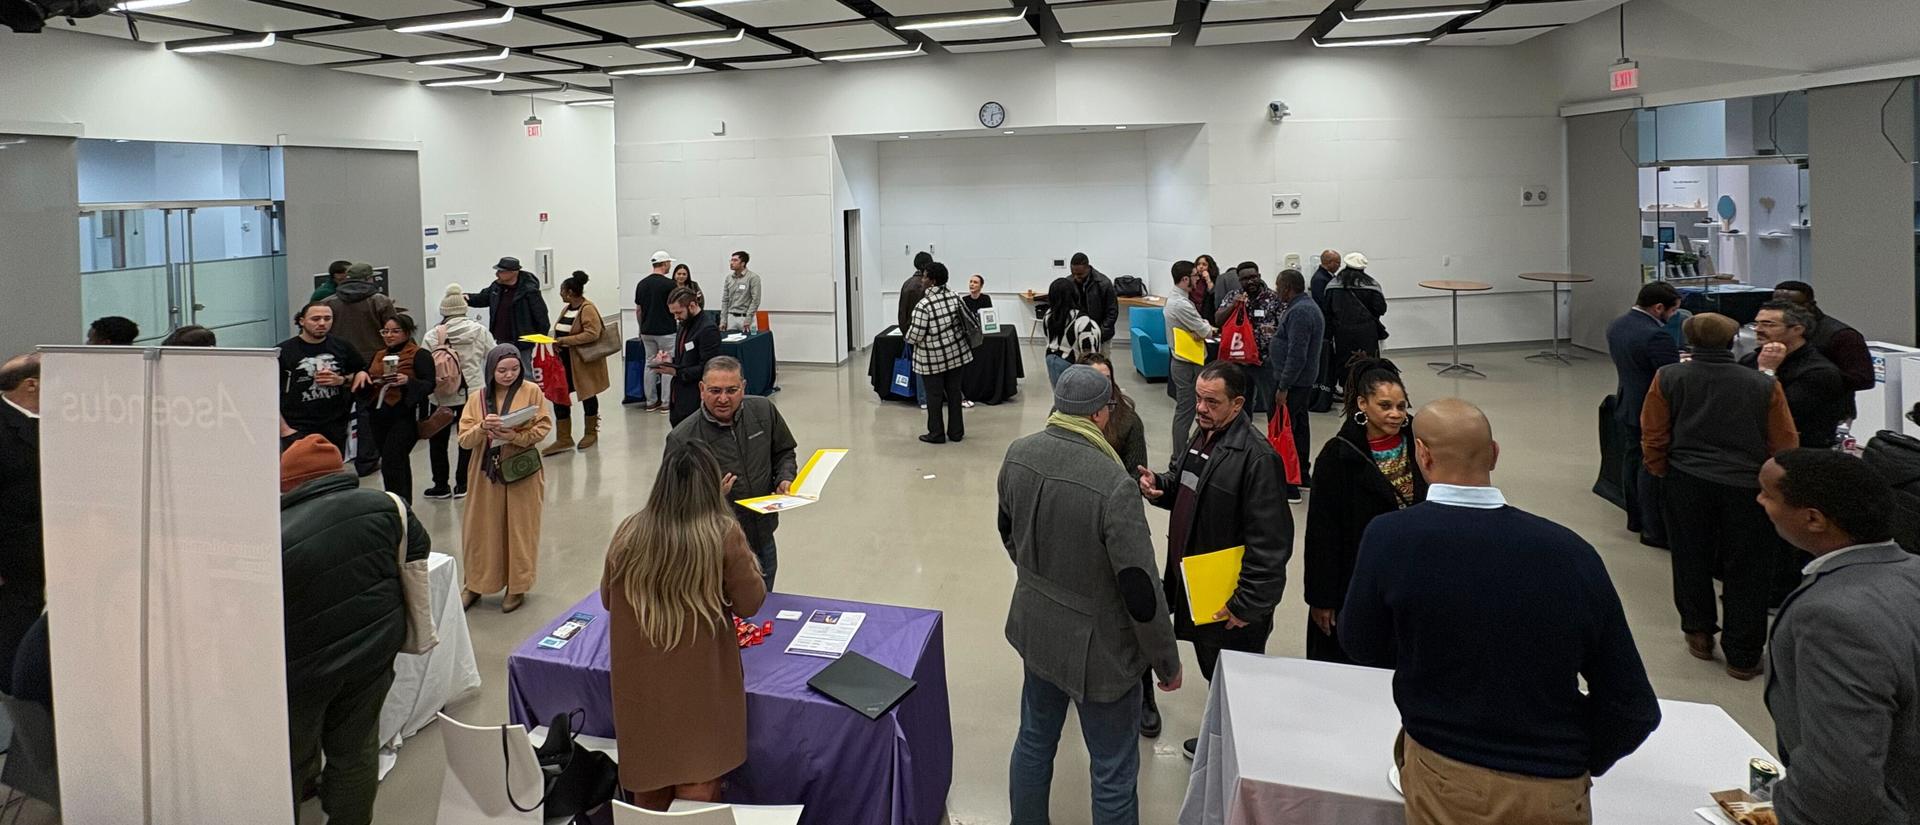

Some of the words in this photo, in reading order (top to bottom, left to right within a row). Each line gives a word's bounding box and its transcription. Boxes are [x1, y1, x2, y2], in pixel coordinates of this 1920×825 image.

[1615, 71, 1633, 89] EXIT
[527, 125, 539, 137] EXIT
[1230, 332, 1244, 350] B
